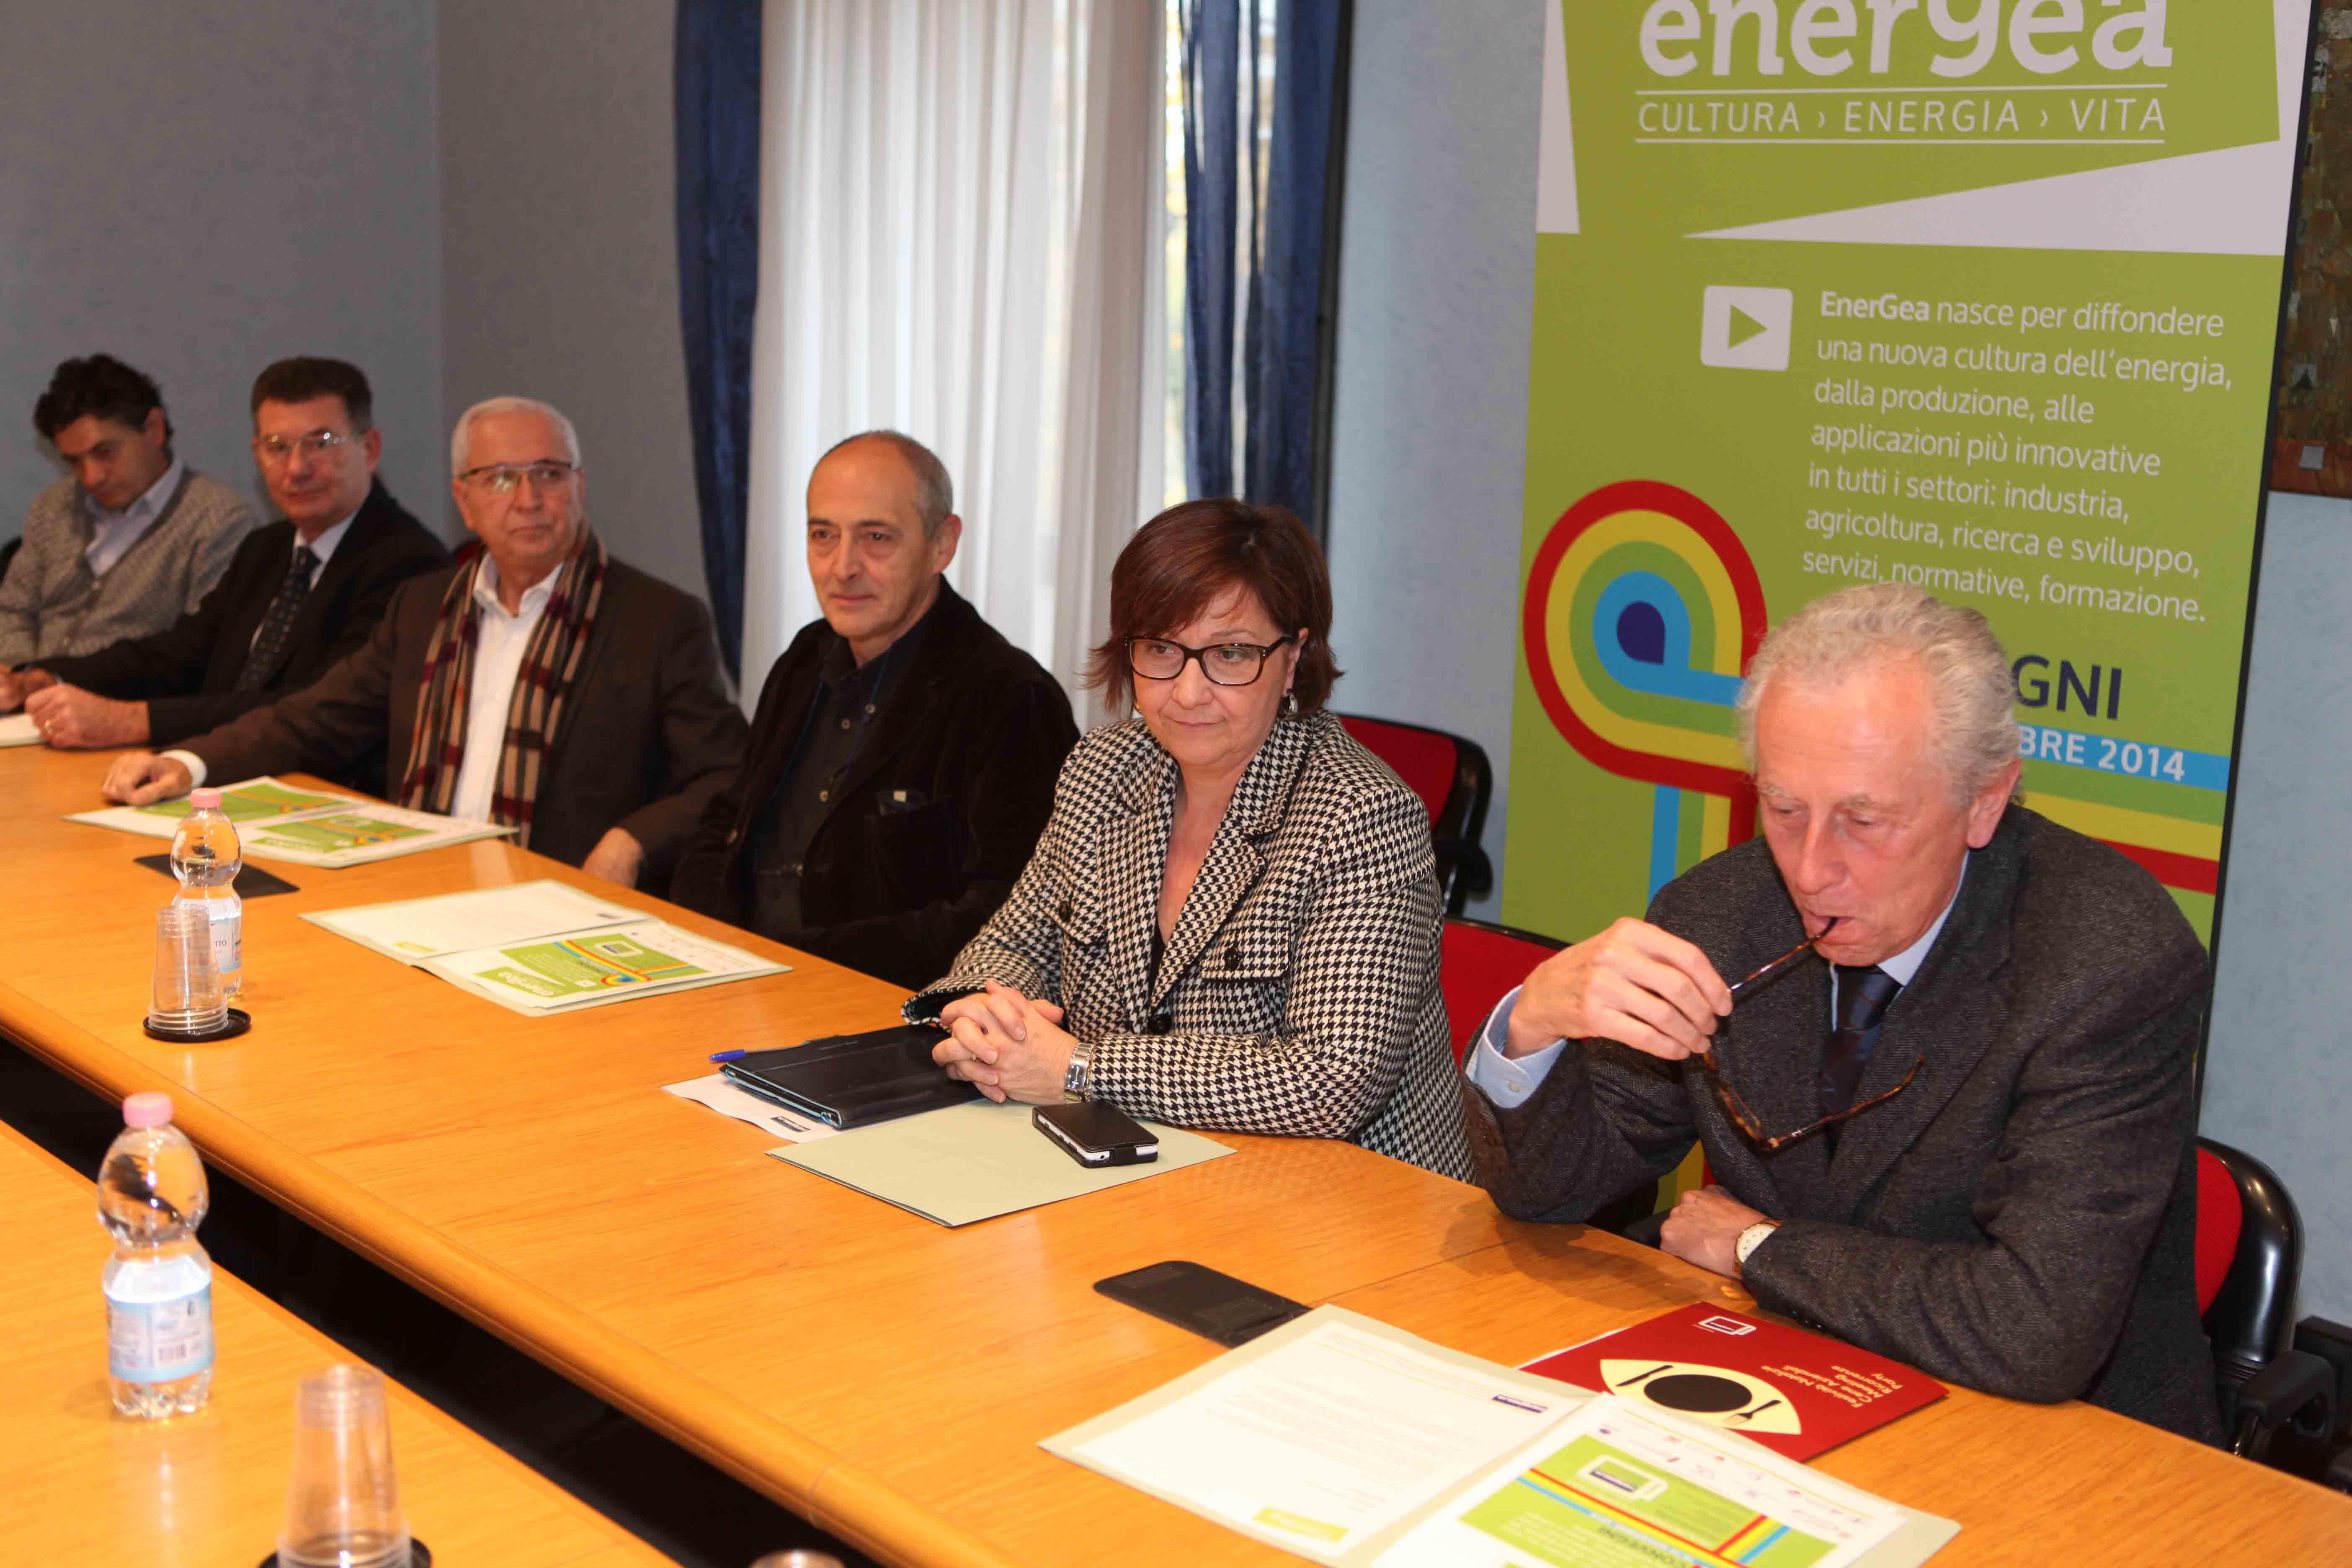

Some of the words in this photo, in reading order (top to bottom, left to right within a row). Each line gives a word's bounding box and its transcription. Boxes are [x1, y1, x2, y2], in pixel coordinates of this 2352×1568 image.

[1639, 0, 2174, 78] energea
[1639, 102, 1800, 132] CULTURA
[1844, 100, 2019, 132] ENERGIA
[2070, 98, 2165, 132] VITA
[1821, 291, 1930, 322] EnerGea
[1937, 300, 2014, 326] nasce
[2020, 306, 2068, 334] per
[2073, 302, 2225, 338] diffondere
[1818, 340, 1863, 362] una
[1869, 343, 1948, 367] nuova
[1954, 343, 2047, 374] cultura
[2054, 348, 2232, 392] dell'energia,
[1814, 377, 1875, 406] dalla
[1881, 384, 2035, 423] produzione,
[2043, 394, 2095, 424] alle
[1811, 423, 1960, 458] applicazioni
[1966, 431, 2008, 466] più
[2015, 440, 2161, 476] innovative
[1809, 462, 1830, 488] in
[1836, 466, 1886, 495] tutti
[1893, 470, 1901, 496] i
[1906, 474, 1997, 506] settori:
[2004, 482, 2130, 524] industria,
[1805, 508, 1944, 548] agricoltura,
[1953, 523, 2040, 555] ricerca
[2047, 536, 2064, 558] e
[2071, 537, 2200, 578] sviluppo,
[1803, 550, 1884, 583] servizi,
[1891, 562, 2030, 603] normative,
[2040, 574, 2205, 622] formazione.
[2011, 655, 2122, 720] GNI
[2017, 725, 2086, 764] BRE
[2098, 739, 2185, 781] 2014
